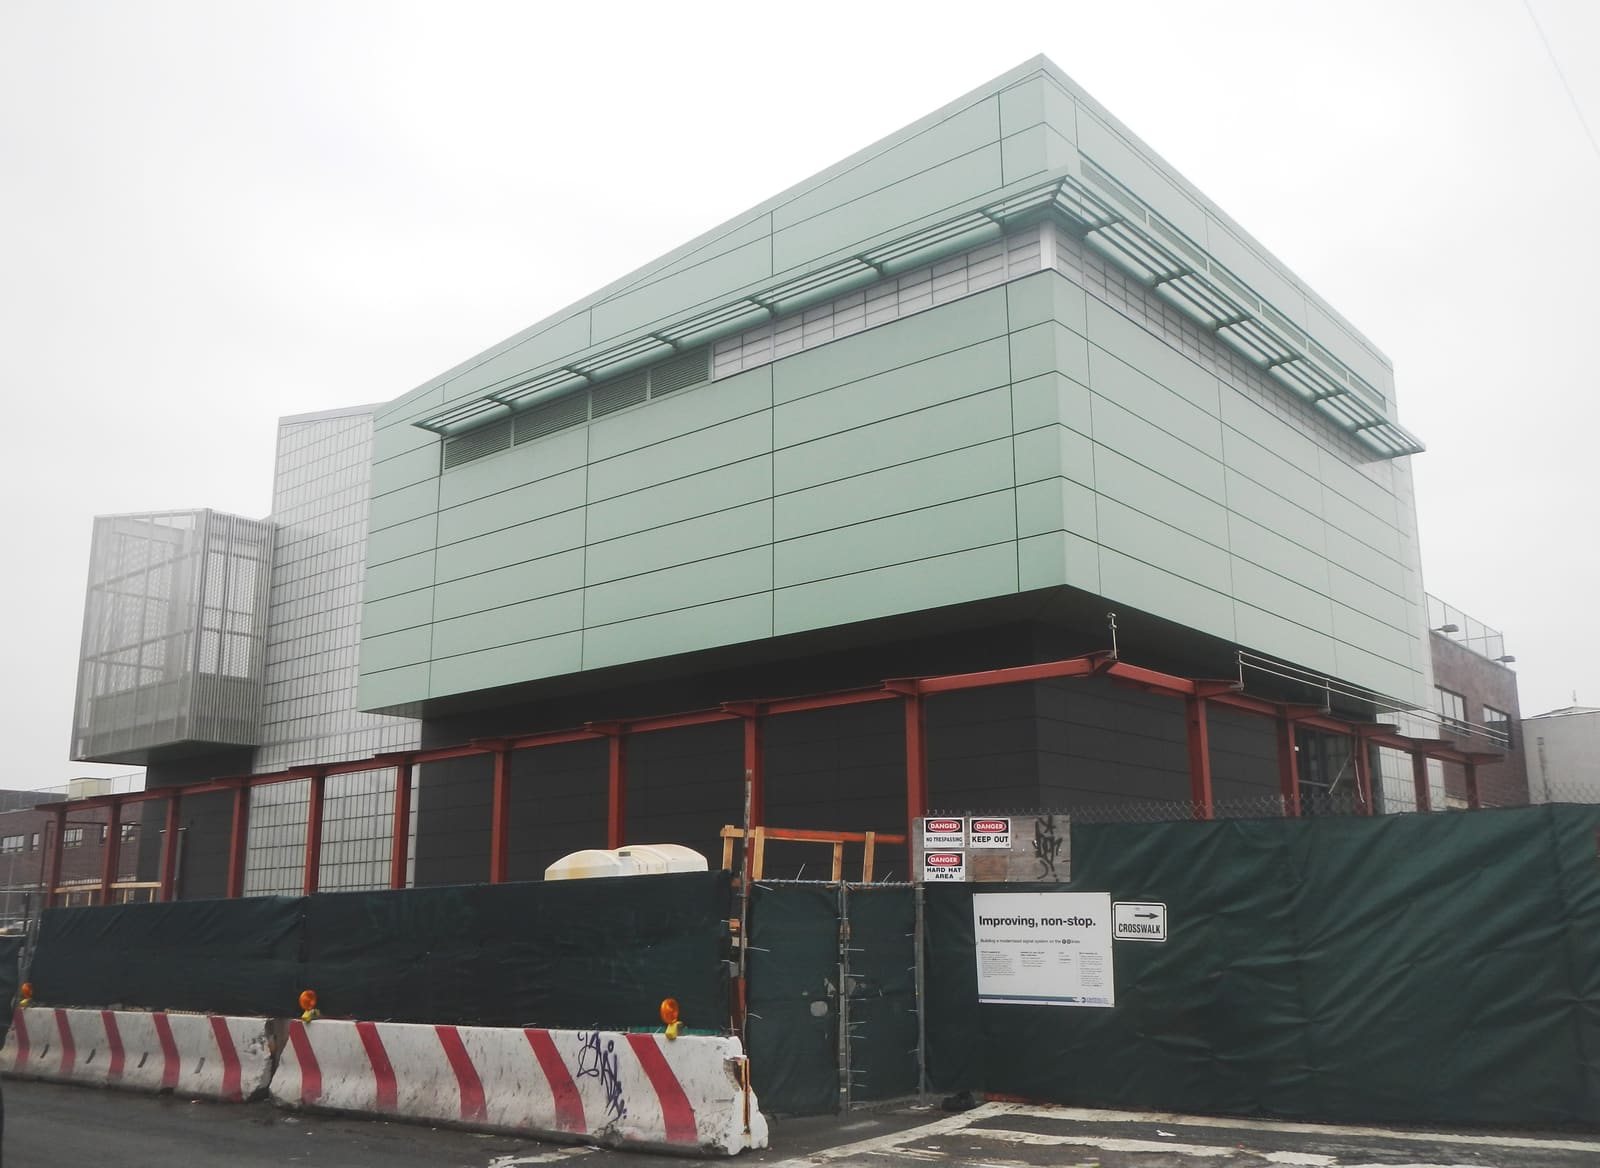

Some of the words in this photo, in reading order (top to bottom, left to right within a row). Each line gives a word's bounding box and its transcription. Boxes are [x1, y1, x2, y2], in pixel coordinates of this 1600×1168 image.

[971, 835, 991, 843] KEEP
[994, 835, 1009, 843] OUT
[979, 915, 1038, 928] Improving,
[1041, 916, 1096, 928] non-stop.
[1118, 922, 1161, 934] CROSSWALK
